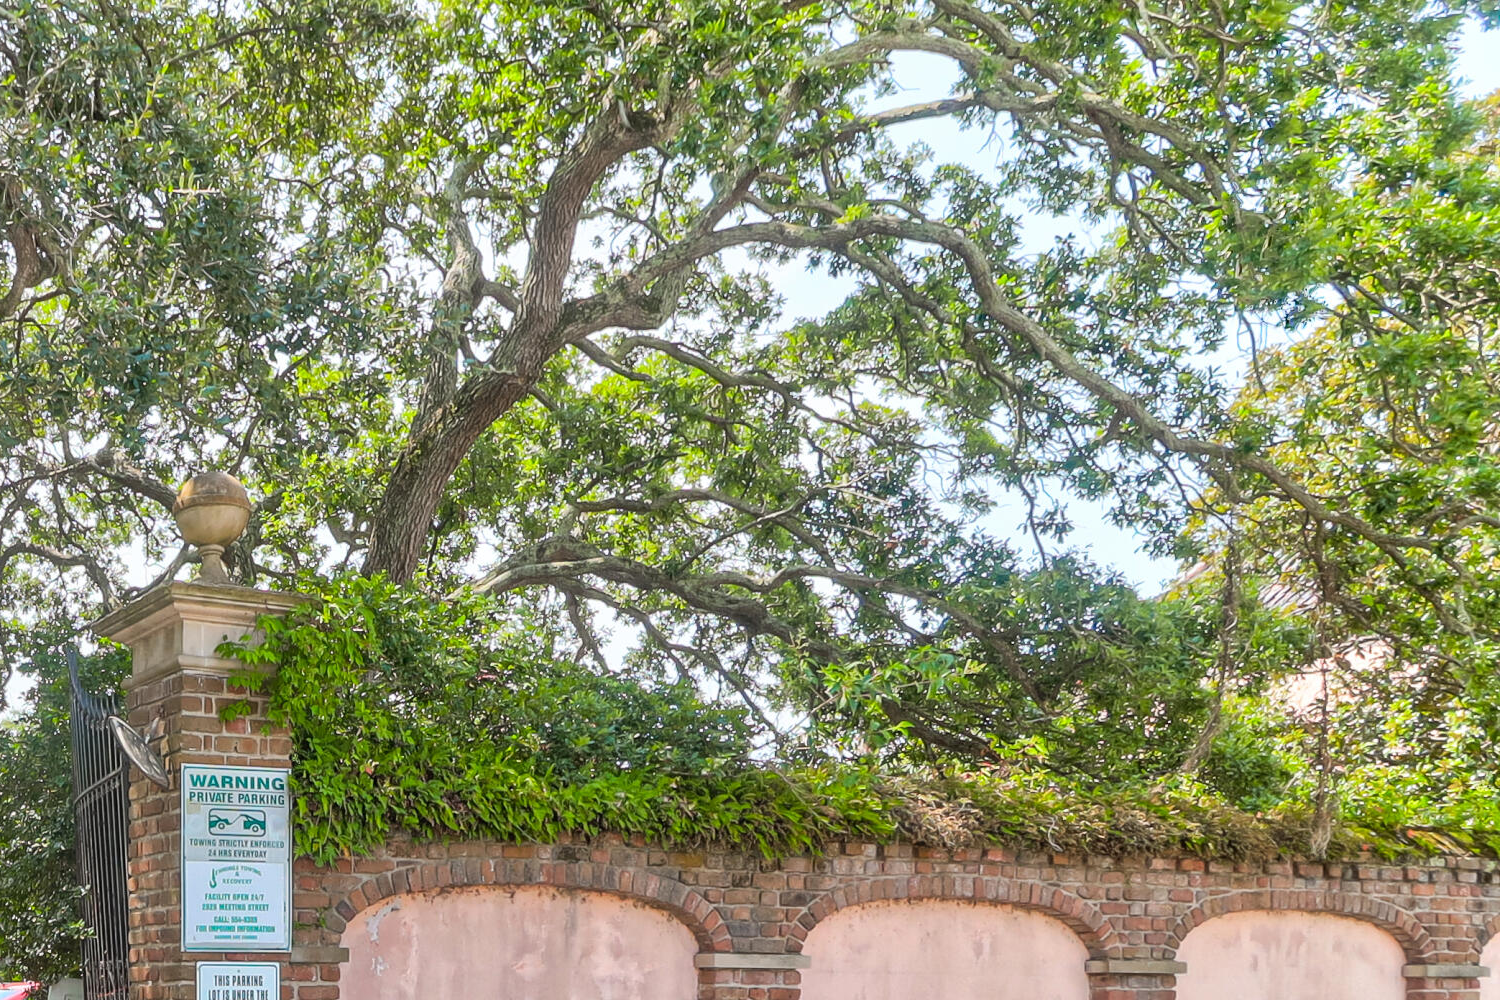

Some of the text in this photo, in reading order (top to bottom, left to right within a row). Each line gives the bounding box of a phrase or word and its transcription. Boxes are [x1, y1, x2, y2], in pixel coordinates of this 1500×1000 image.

[189, 774, 285, 791] WARNING
[189, 791, 285, 805] PRIVATE PARKING
[189, 838, 285, 849] TOWING STRICTLY ENFORCED
[208, 849, 267, 858] 24 HRS EVERYDAY
[232, 893, 249, 901] OPEN
[214, 975, 263, 987] THIS PARKING
[208, 989, 268, 1000] LOT IS UNDER THE
